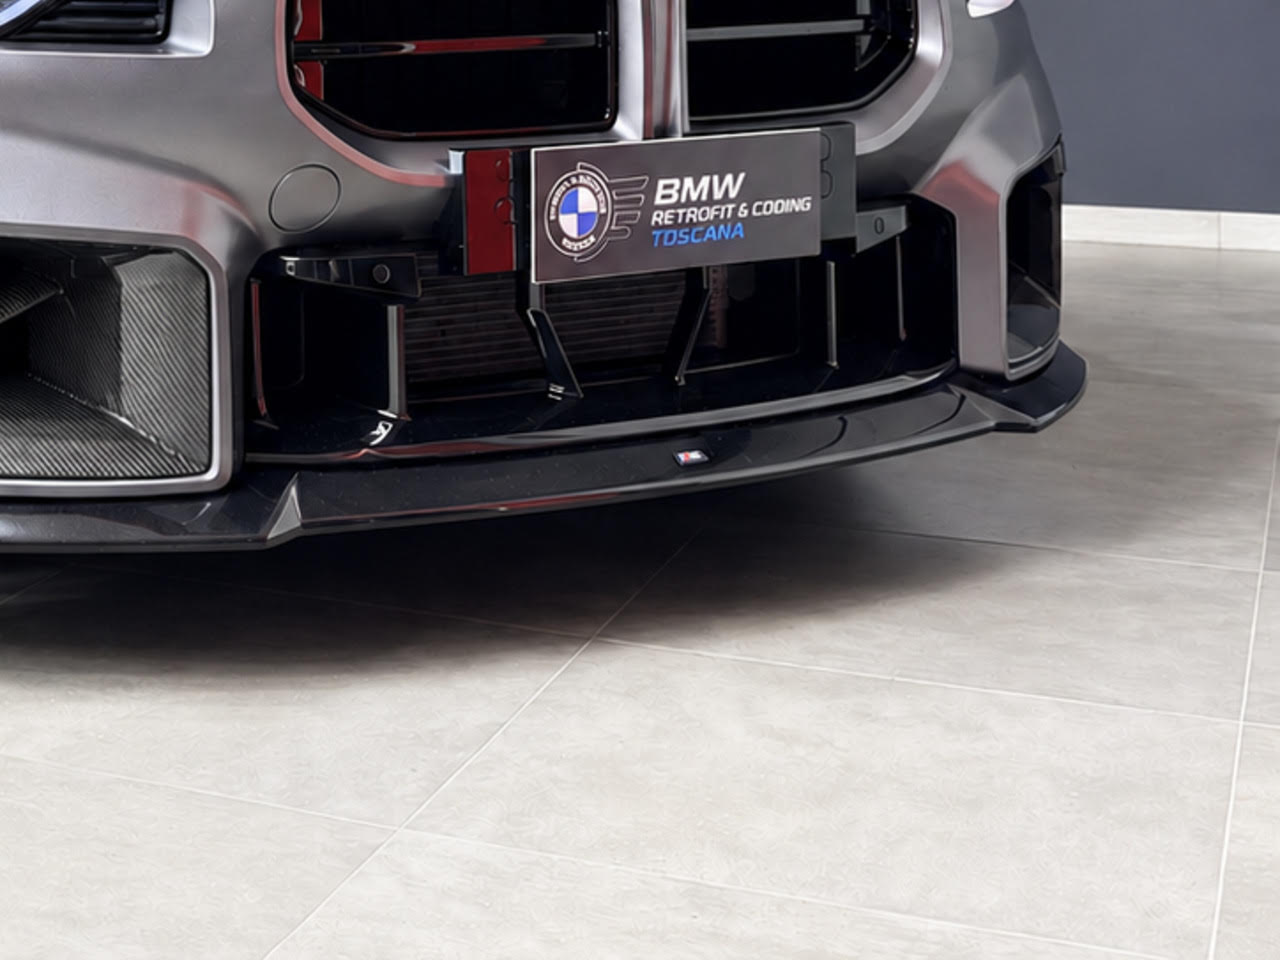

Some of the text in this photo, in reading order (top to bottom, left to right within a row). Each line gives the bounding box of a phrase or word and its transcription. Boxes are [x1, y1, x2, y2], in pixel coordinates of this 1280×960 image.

[654, 172, 746, 206] BMW
[651, 197, 812, 226] RETROFIT & CODING
[652, 222, 745, 248] TOSCANA
